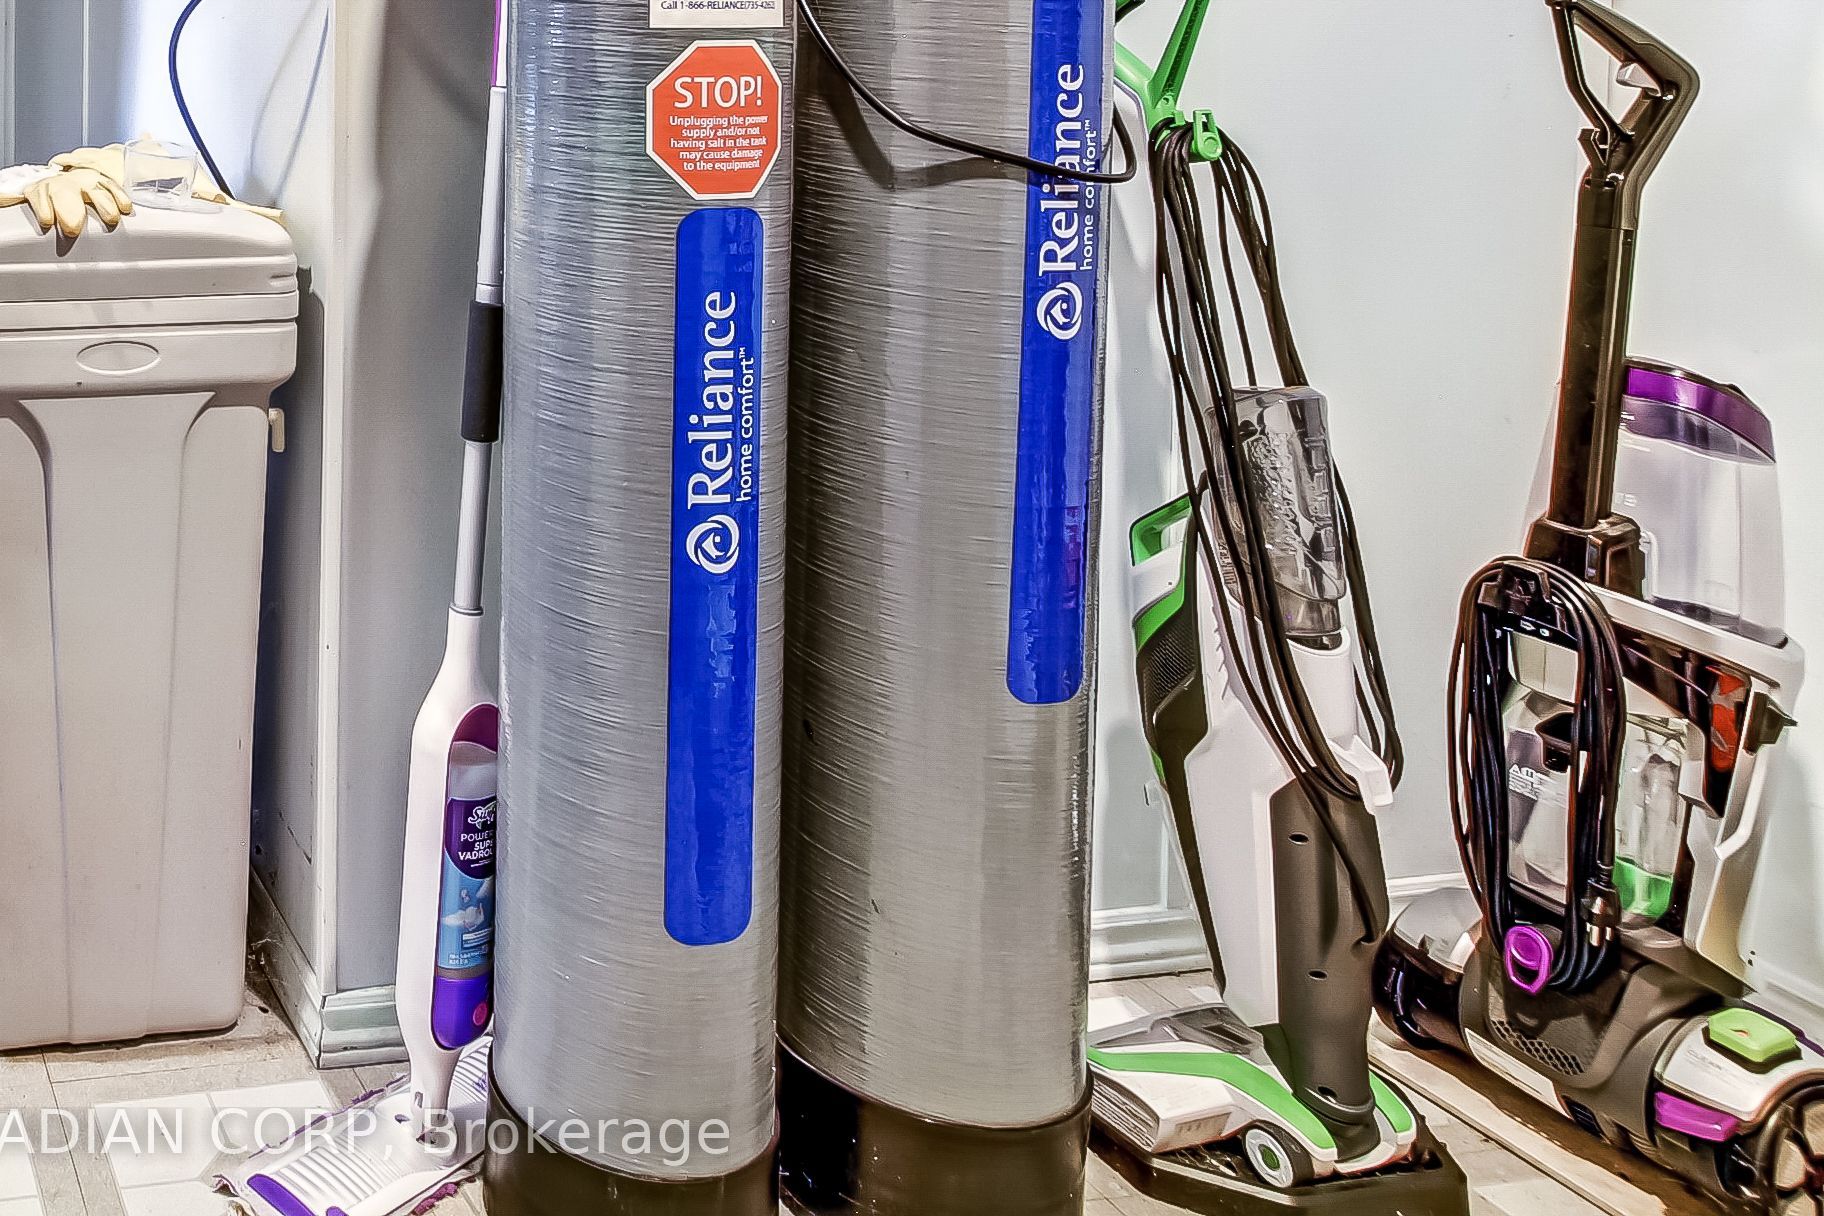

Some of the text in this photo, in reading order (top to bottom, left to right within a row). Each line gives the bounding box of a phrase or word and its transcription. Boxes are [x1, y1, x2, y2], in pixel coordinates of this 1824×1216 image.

[661, 0, 678, 10] Call
[673, 76, 762, 108] STOP!
[669, 116, 768, 127] Unplugging the power
[682, 126, 760, 138] supply and/or not
[671, 137, 767, 149] having salt in the tank
[679, 148, 763, 161] may cause damage
[683, 160, 760, 172] to the equipment
[1039, 64, 1084, 277] Reliance
[1079, 215, 1094, 271] home
[687, 291, 736, 510] Reliance
[736, 444, 752, 501] home
